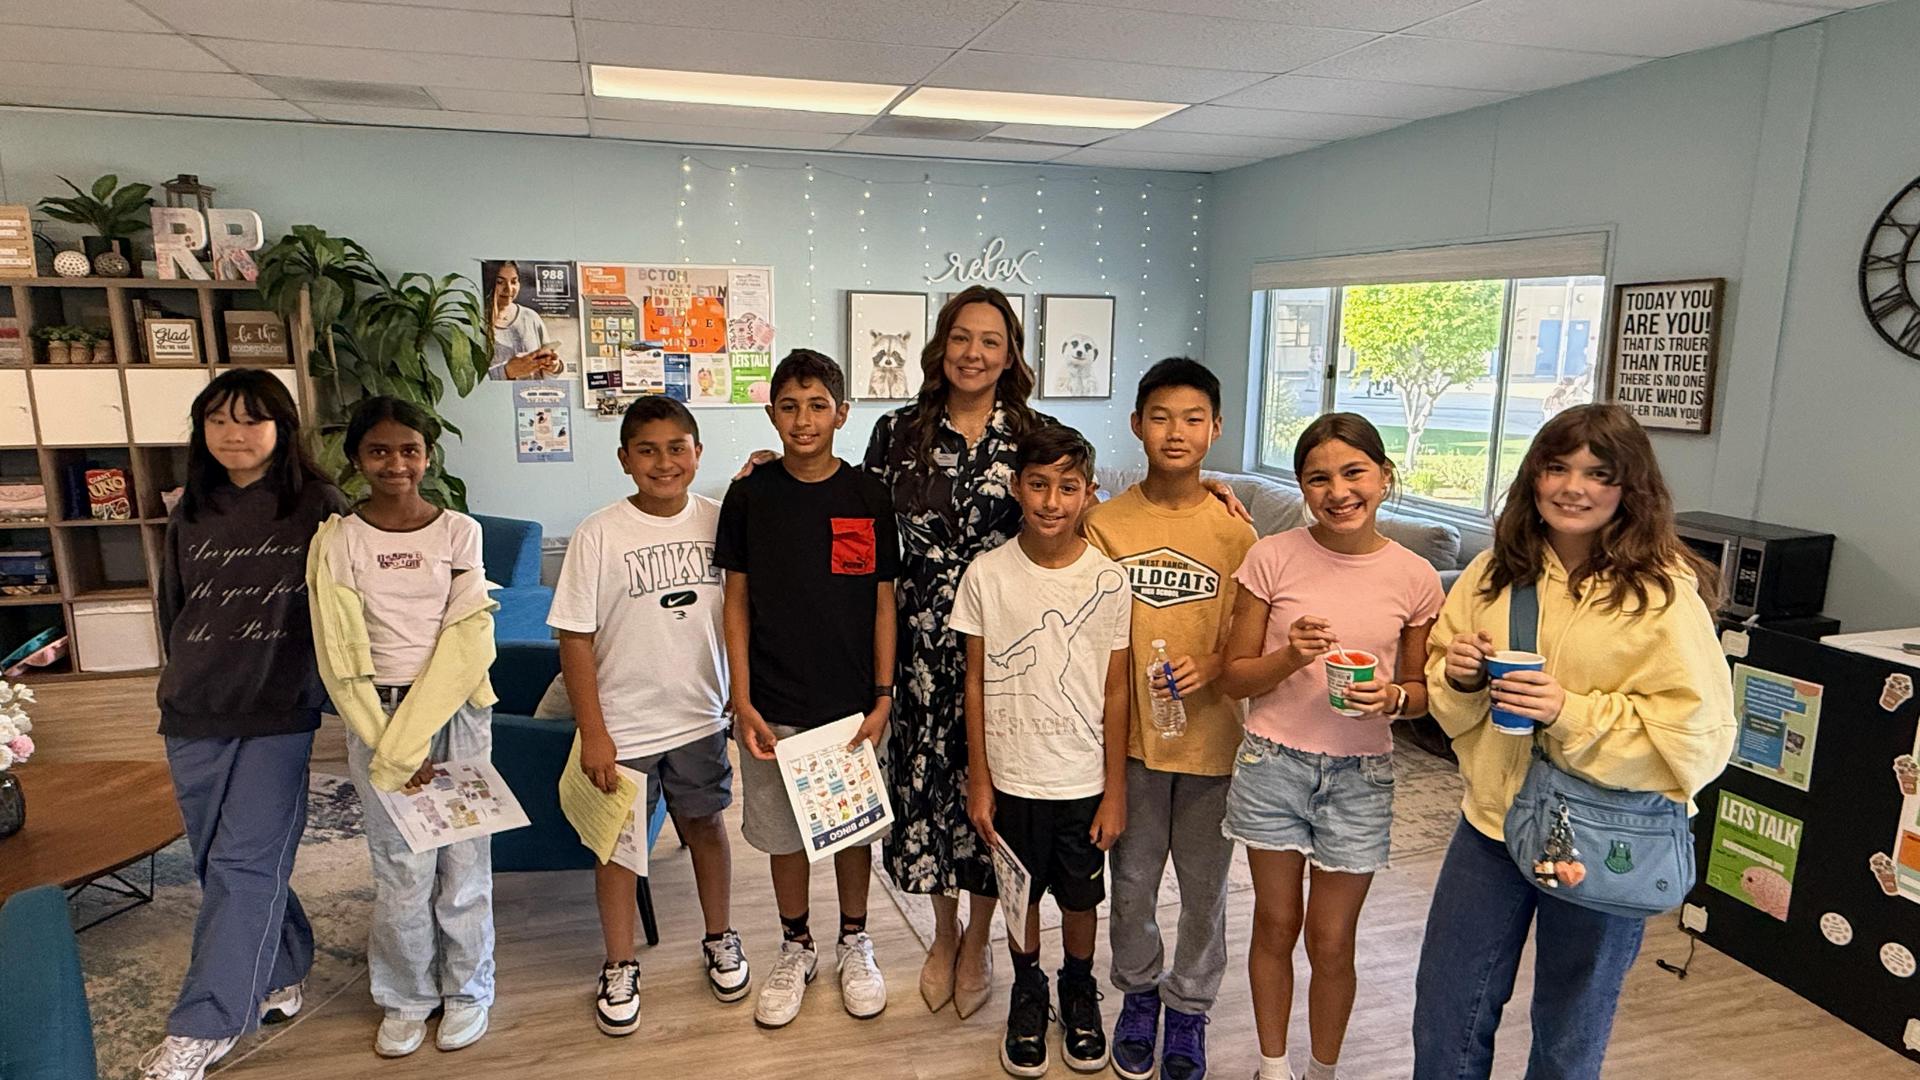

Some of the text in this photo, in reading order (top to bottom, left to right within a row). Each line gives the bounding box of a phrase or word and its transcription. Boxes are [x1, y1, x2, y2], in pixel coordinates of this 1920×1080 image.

[927, 238, 1039, 286] relax
[542, 269, 564, 280] 988
[1626, 289, 1713, 311] TODAY YOU
[1623, 311, 1710, 335] ARE YOU!
[153, 328, 191, 345] Glad
[1623, 337, 1708, 352] THAT IS TRUER
[732, 354, 769, 368] LETS TALK
[1622, 354, 1707, 372] THAN TRUE!
[1620, 373, 1704, 388] THERE IS NO ONE
[1618, 387, 1704, 406] ALIVE WHO IS
[1652, 405, 1677, 418] THAN
[1680, 407, 1703, 420] YOU!
[88, 476, 126, 497] UNO
[624, 541, 720, 598] NIKE
[1138, 559, 1189, 570] WEST RANCH
[1124, 566, 1216, 593] ILDCATS
[829, 816, 870, 841] RP BINGO
[1720, 796, 1757, 832] LETS
[1758, 811, 1800, 850] TALK
